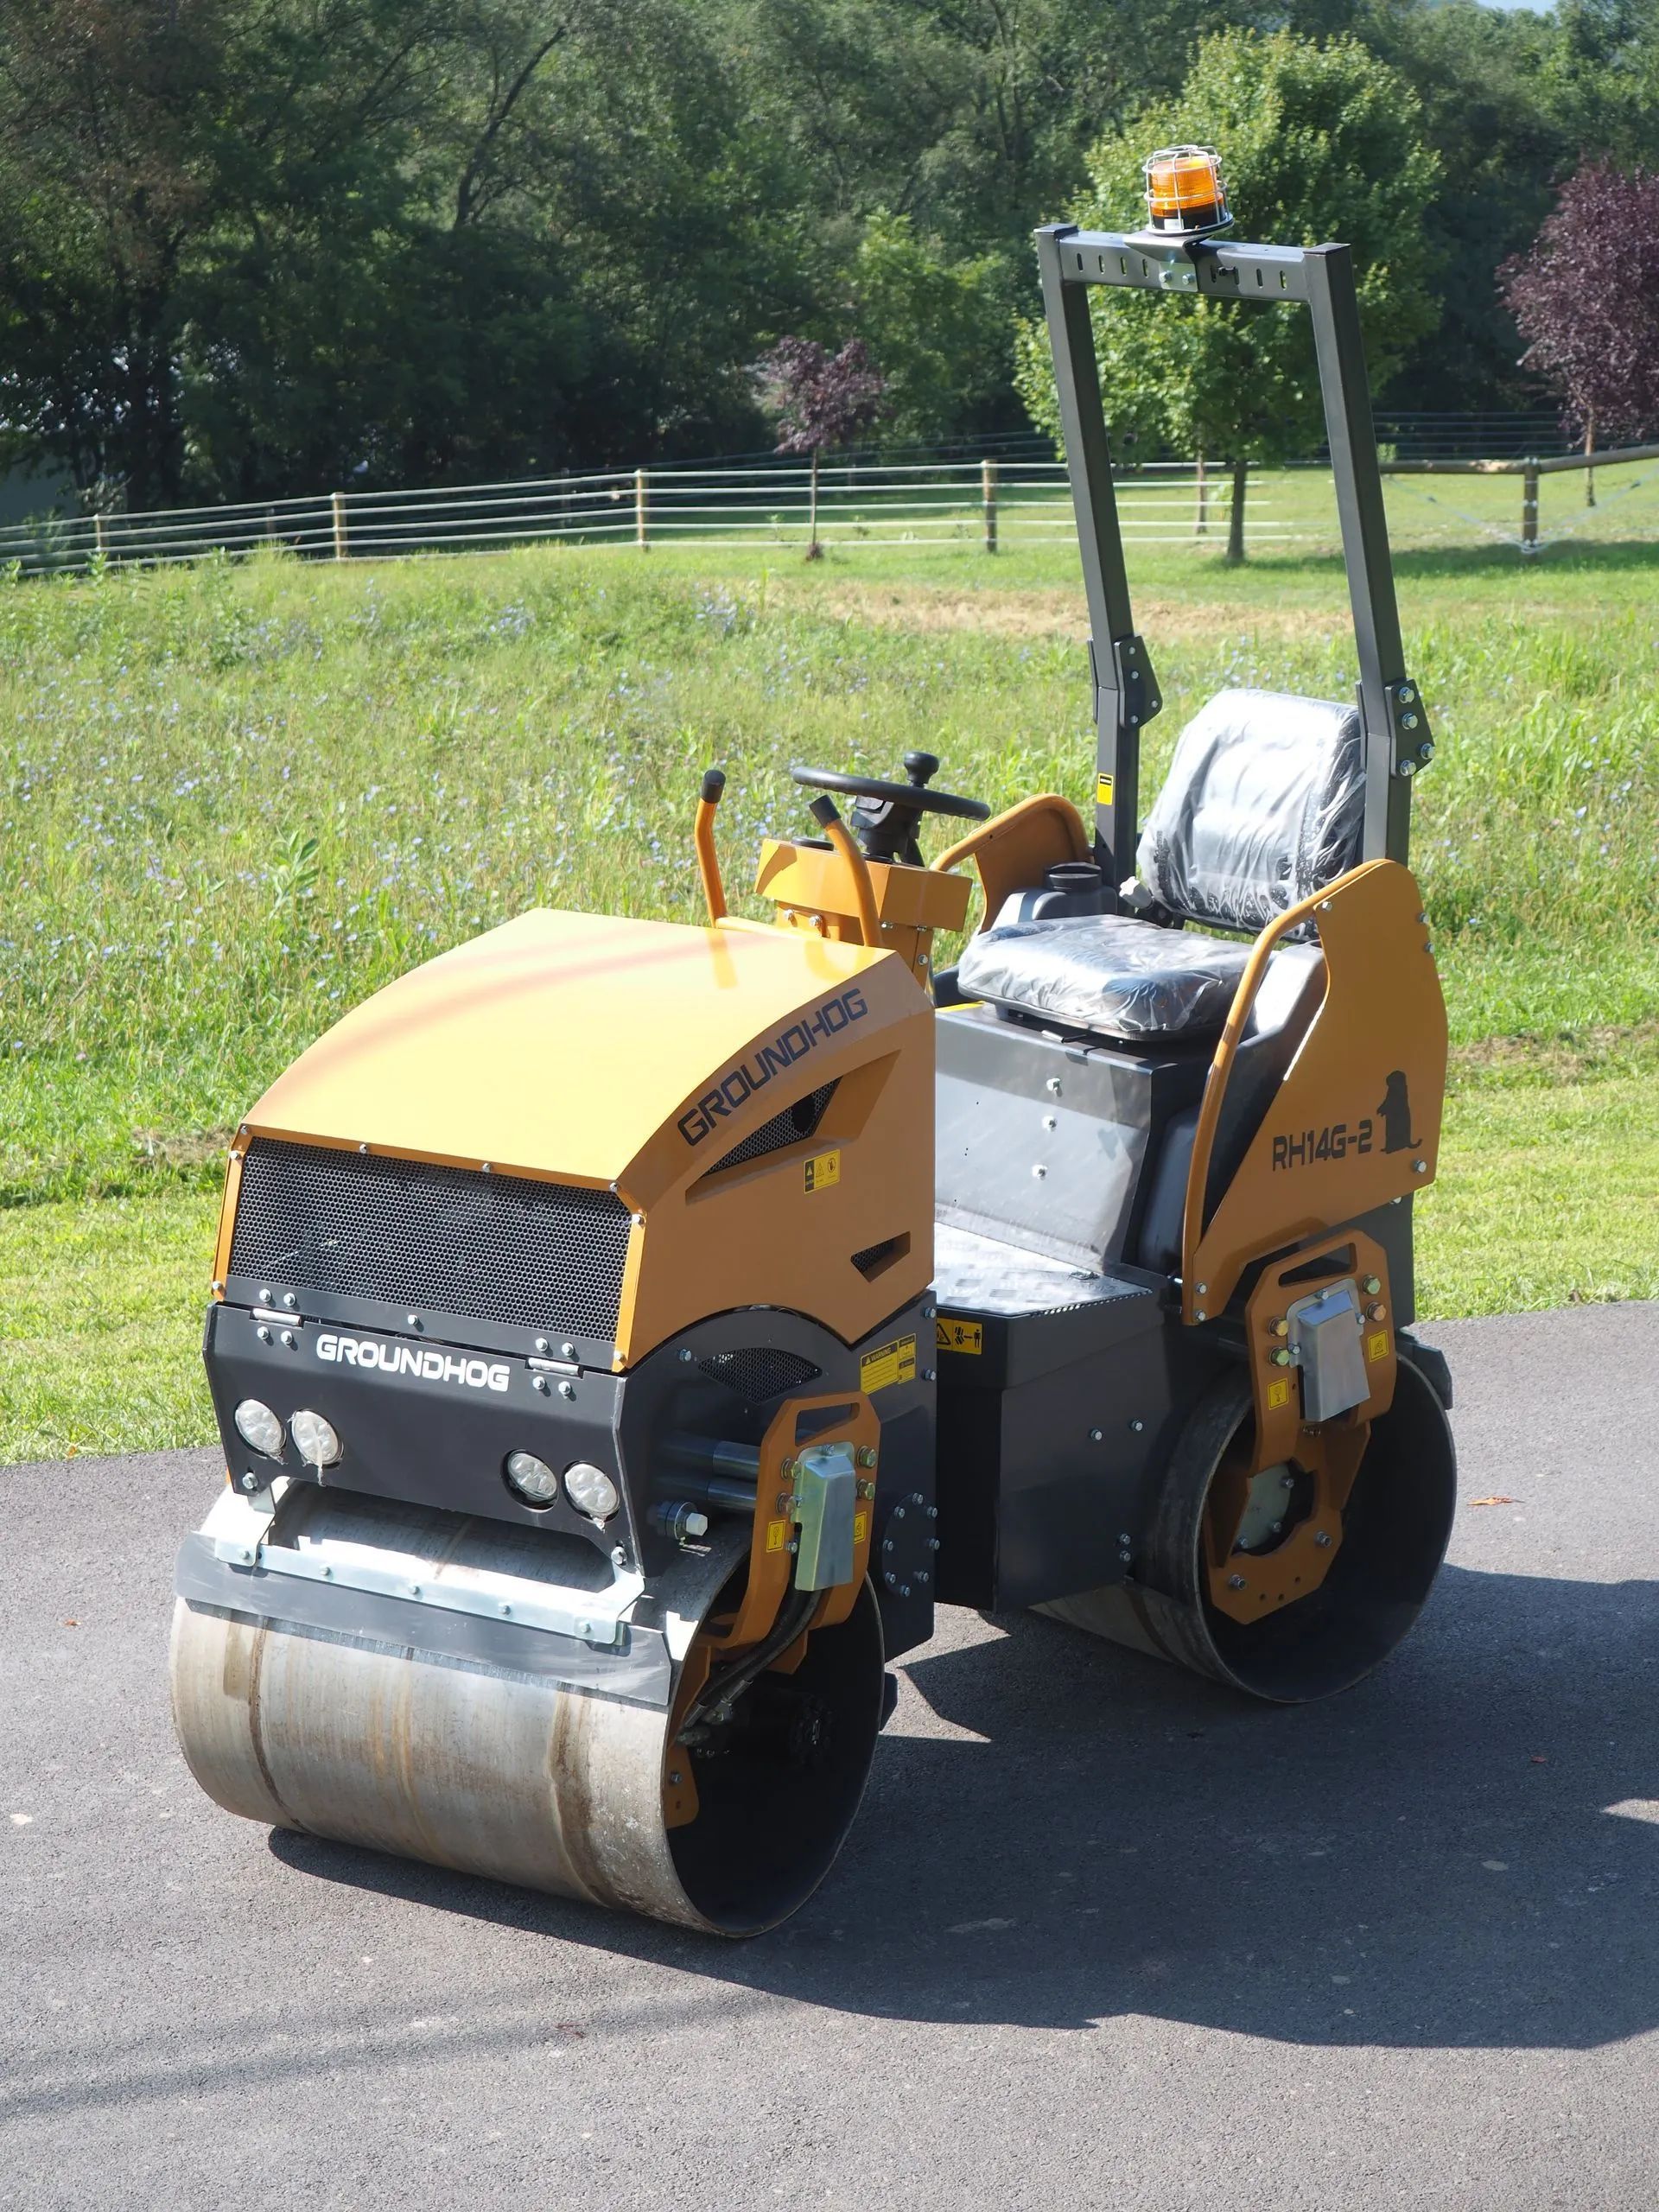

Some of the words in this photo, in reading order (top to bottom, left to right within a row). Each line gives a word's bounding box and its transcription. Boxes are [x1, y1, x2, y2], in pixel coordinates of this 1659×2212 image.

[677, 988, 868, 1146] GROUNDHOG
[1273, 1119, 1372, 1172] RH14G-2
[316, 1333, 510, 1392] GROUNDHOG
[870, 1347, 891, 1361] WARNING
